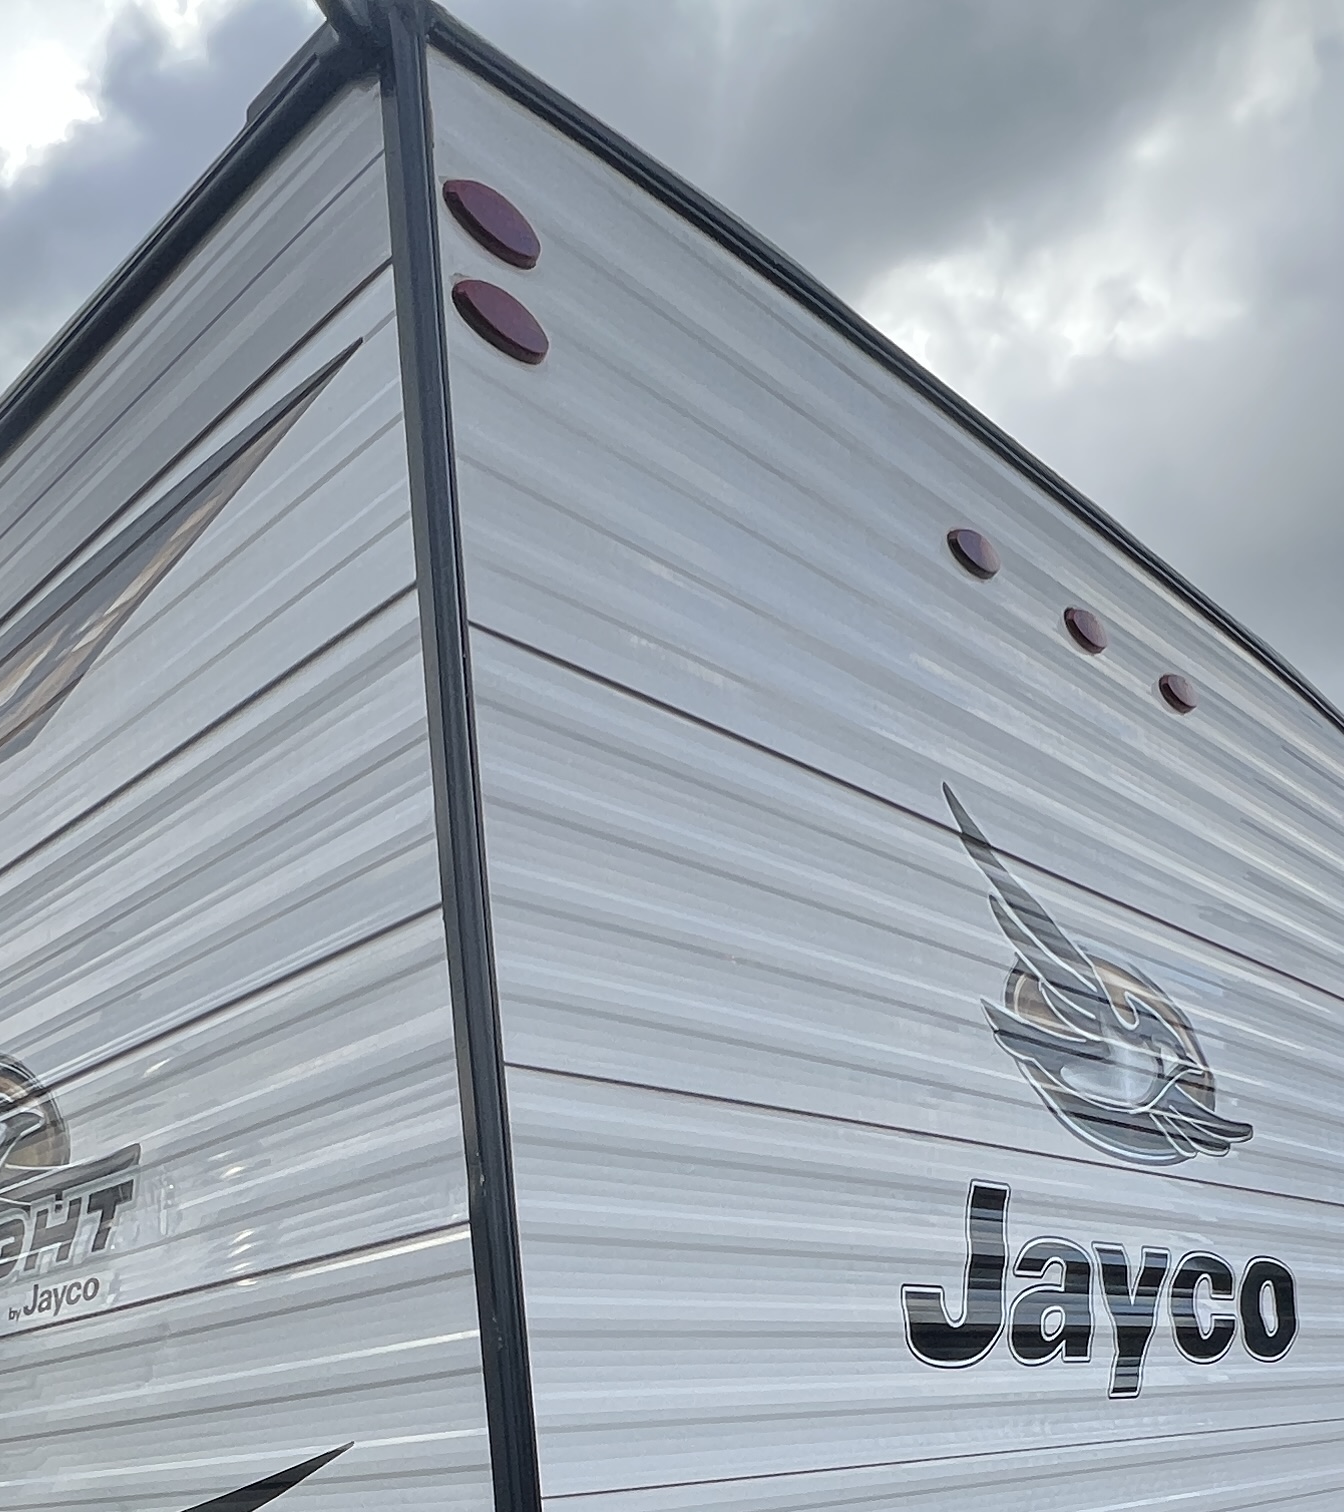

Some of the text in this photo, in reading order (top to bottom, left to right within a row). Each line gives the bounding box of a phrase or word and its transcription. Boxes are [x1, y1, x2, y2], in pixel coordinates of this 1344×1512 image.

[8, 1277, 100, 1322] by Jayco
[902, 1179, 1299, 1399] Jayco
